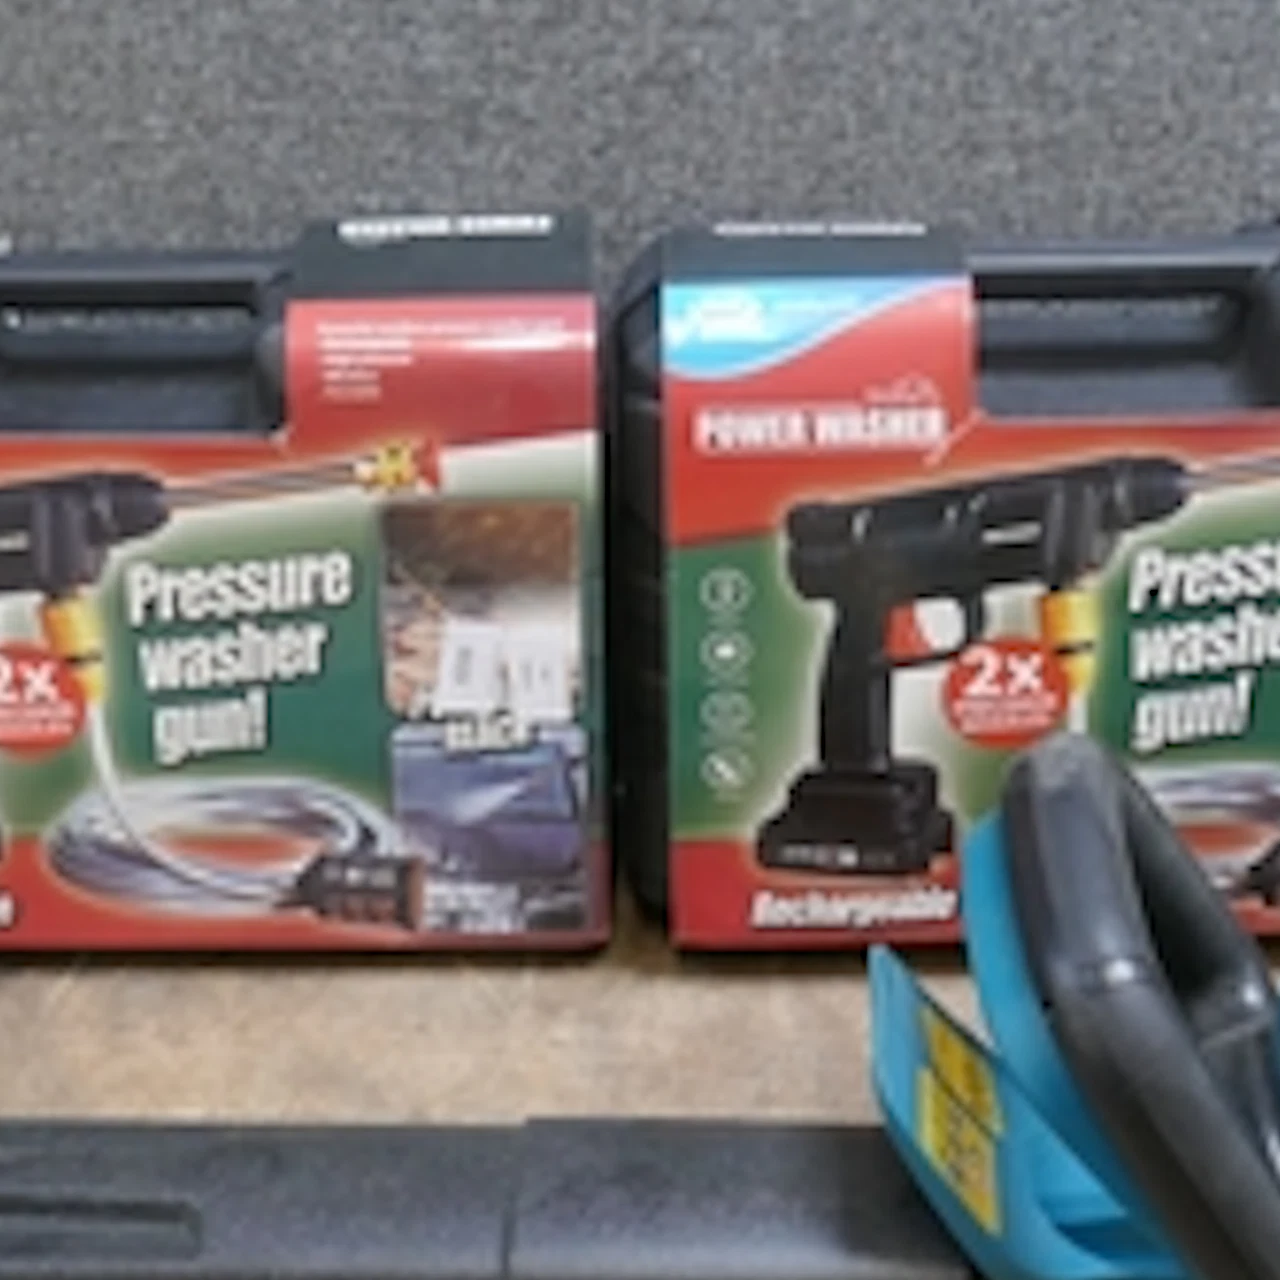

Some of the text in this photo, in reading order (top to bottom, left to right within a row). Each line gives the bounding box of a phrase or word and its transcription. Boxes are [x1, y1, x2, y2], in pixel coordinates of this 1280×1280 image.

[127, 549, 354, 628] Pressure
[137, 620, 329, 693] washer
[151, 684, 268, 767] gun!
[1129, 668, 1254, 757] gun!
[751, 884, 958, 929] Rechargeable
